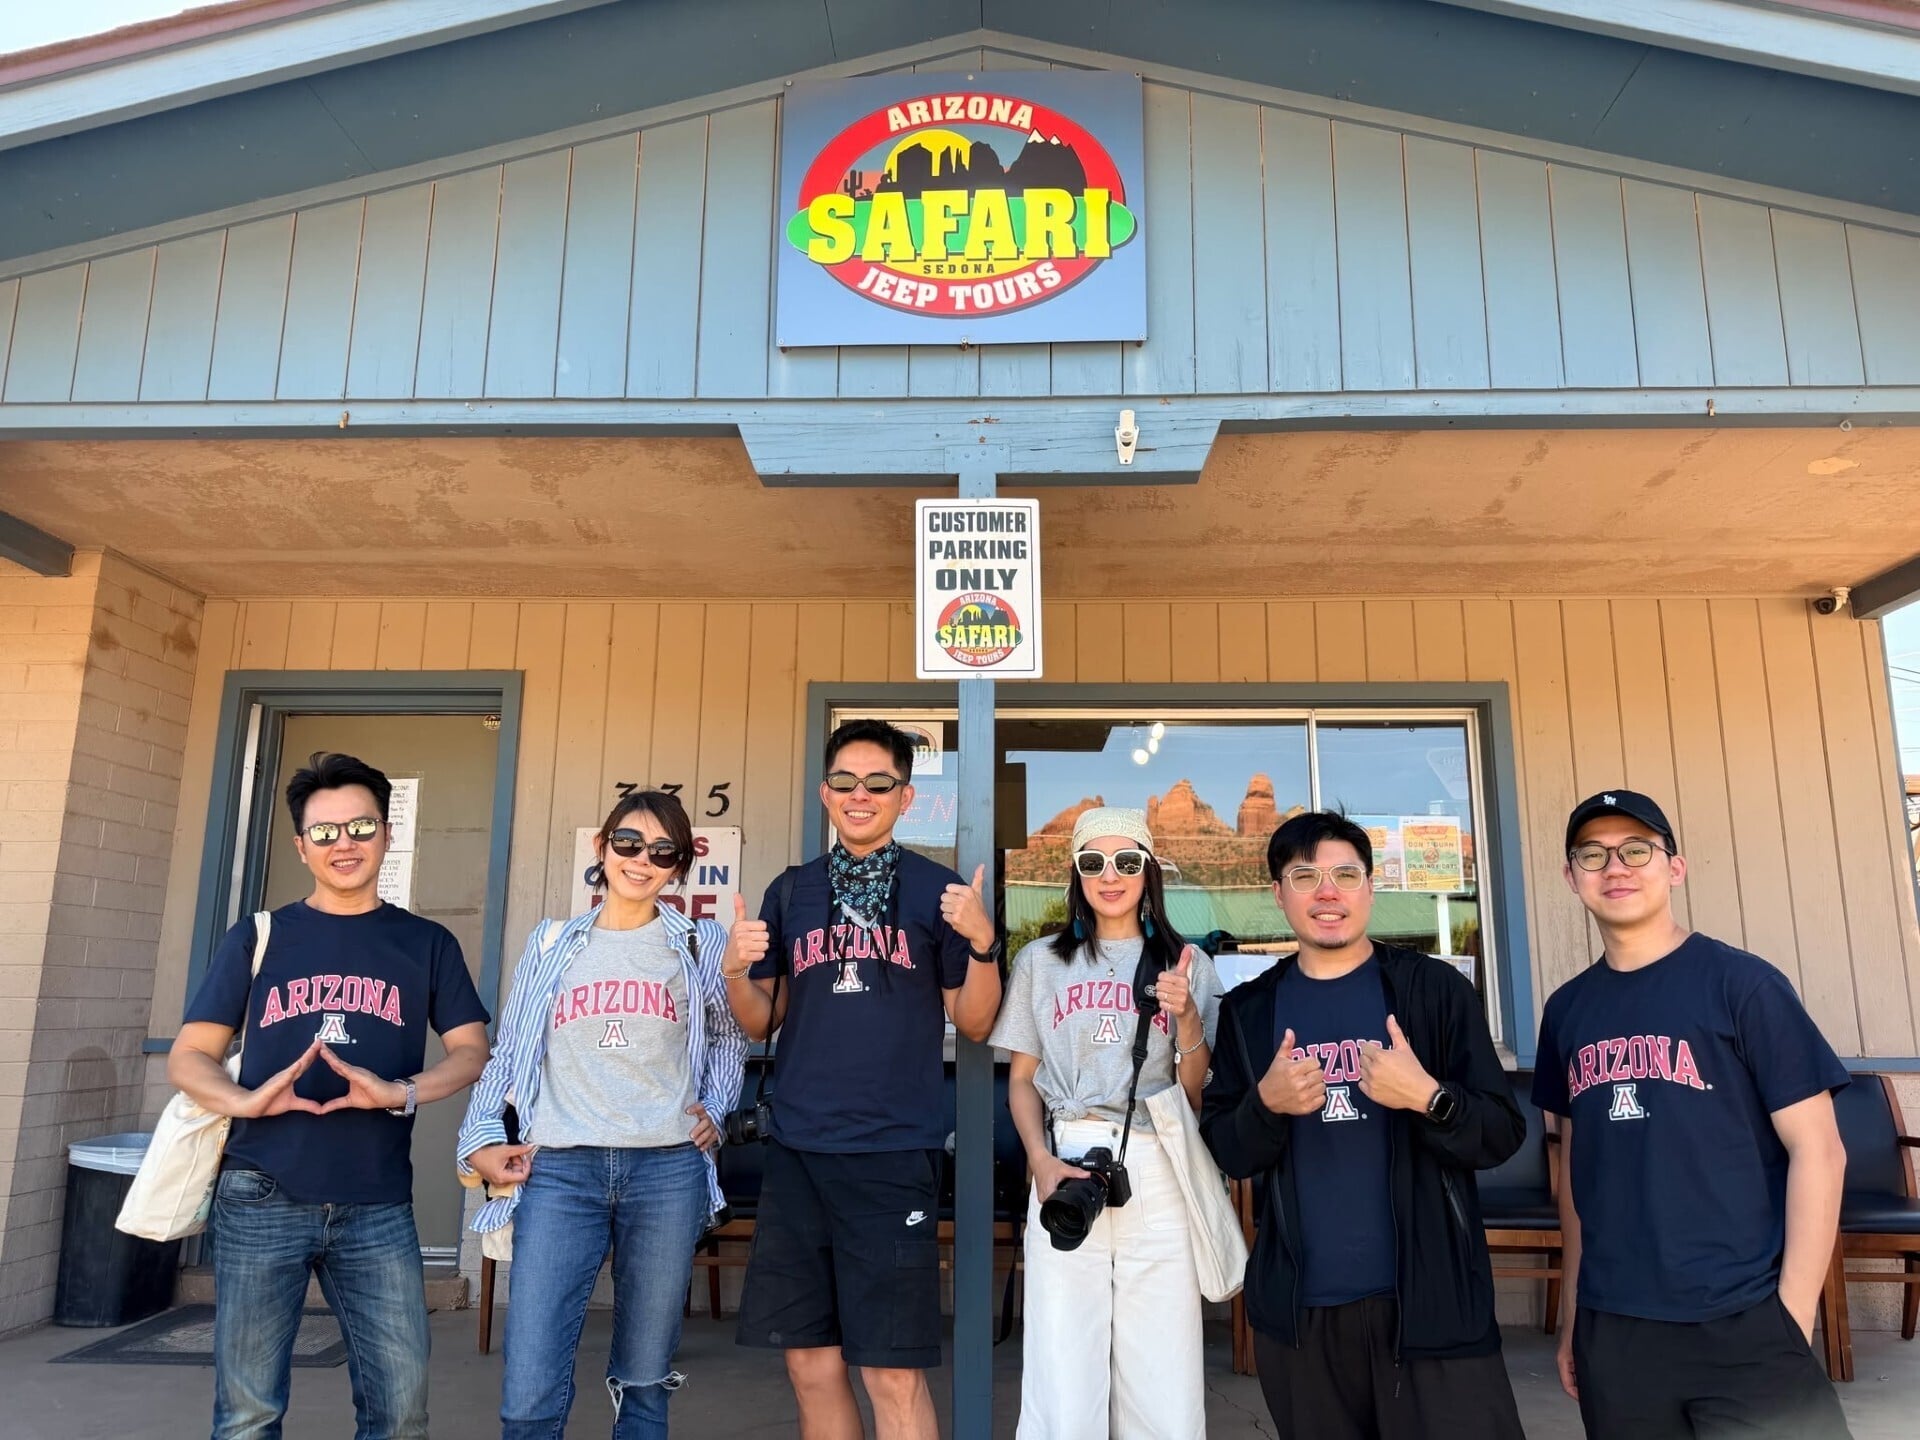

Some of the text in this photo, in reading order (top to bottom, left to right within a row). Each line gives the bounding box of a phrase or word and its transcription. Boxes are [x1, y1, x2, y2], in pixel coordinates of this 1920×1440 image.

[887, 96, 1034, 132] ARIZONA
[808, 188, 1111, 264] SAFARI
[923, 264, 995, 275] SEDONA
[857, 261, 1062, 310] JEEP TOURS
[929, 511, 1026, 533] CUSTOMER
[929, 540, 1027, 560] PARKING
[936, 568, 1018, 591] ONLY
[960, 593, 997, 606] ARIZONA
[940, 624, 1016, 648] SAFARI
[698, 865, 729, 885] IN
[833, 961, 863, 993] A
[260, 974, 402, 1028] ARIZONA
[554, 978, 678, 1031] ARIZONA
[1053, 980, 1170, 1036] ARIZOA
[315, 1013, 350, 1044] A
[598, 1019, 629, 1049] A
[1091, 1014, 1122, 1044] A
[1568, 1034, 1705, 1104] ARIZONA
[1322, 1086, 1359, 1122] A
[1609, 1083, 1644, 1121] A
